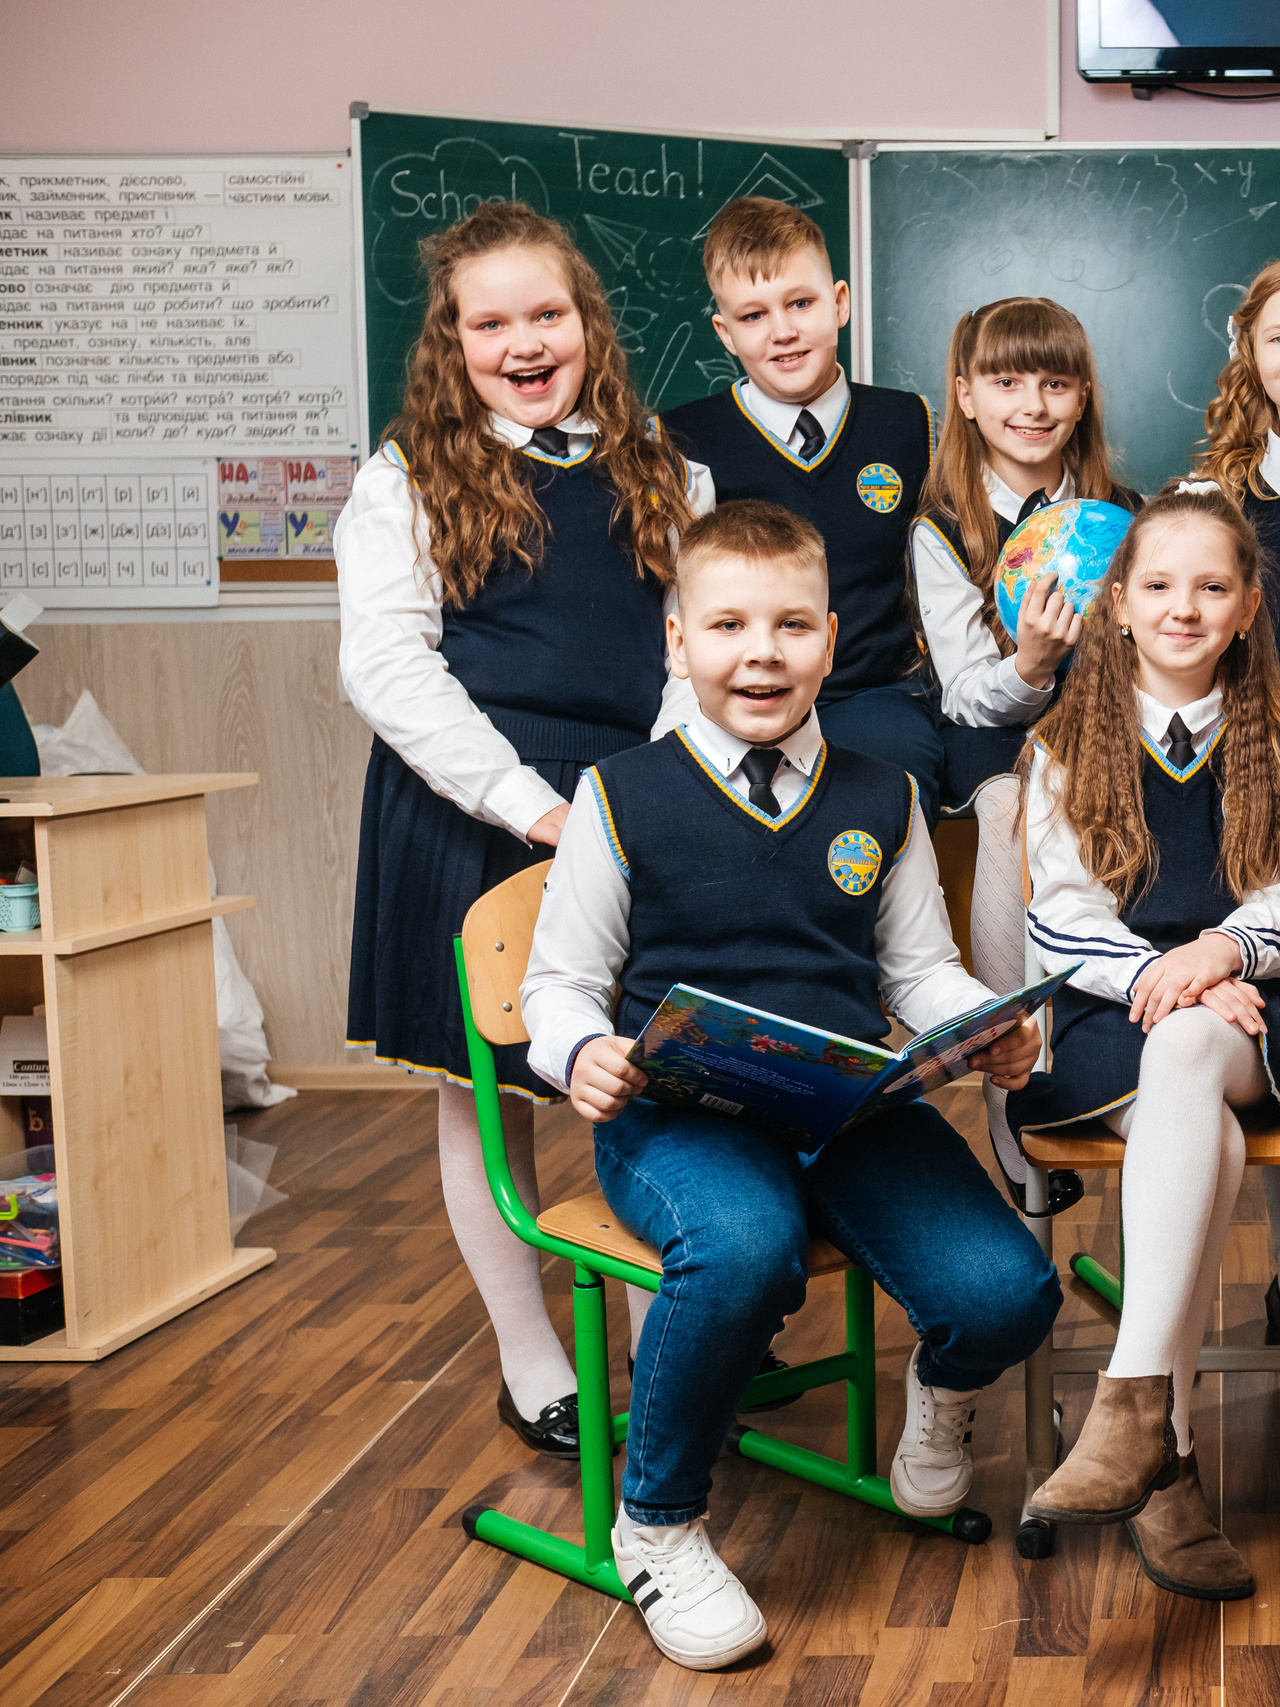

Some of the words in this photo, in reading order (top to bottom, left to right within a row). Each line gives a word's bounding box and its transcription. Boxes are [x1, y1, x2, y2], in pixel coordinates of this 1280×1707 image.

[20, 176, 110, 188] прикметник,
[228, 172, 305, 185] самостійні
[29, 189, 110, 203] займенник,
[119, 189, 197, 204] прислівник
[228, 192, 286, 204] частини
[293, 192, 334, 203] мови.
[391, 169, 517, 220] Schol
[26, 209, 86, 221] називає
[94, 209, 156, 223] предмет
[37, 229, 54, 240] на
[63, 229, 122, 240] питання
[131, 224, 163, 240] хто?
[172, 224, 203, 240] що?
[63, 246, 123, 257] називає
[131, 247, 182, 260] ознаку
[190, 245, 260, 260] предмета
[38, 265, 56, 276] на
[65, 265, 124, 276] питання
[132, 261, 174, 275] який?
[183, 260, 216, 274] яка?
[225, 260, 258, 274] яке?
[266, 259, 294, 273] які?
[35, 283, 93, 294] означає
[110, 280, 135, 294] дію
[143, 281, 213, 296] предмета
[40, 301, 58, 312] на
[66, 301, 125, 312] питання
[133, 301, 156, 313] що
[164, 297, 223, 315] робити?
[231, 300, 254, 312] що
[261, 295, 330, 314] зробити?
[111, 319, 128, 330] на
[140, 319, 158, 330] не
[166, 317, 225, 329] називає
[13, 337, 79, 351] предмет,
[88, 337, 141, 351] ознаку,
[150, 334, 216, 348] кількість,
[225, 336, 251, 347] але
[46, 355, 112, 366] позначає
[119, 352, 180, 366] кількість
[188, 351, 260, 367] предметів
[268, 351, 294, 365] або
[1, 374, 60, 387] порядок
[67, 371, 89, 386] під
[95, 374, 120, 384] час
[127, 370, 164, 384] лічби
[172, 372, 187, 383] та
[194, 369, 269, 384] відповідає
[53, 391, 113, 407] скільки?
[115, 412, 129, 423] та
[137, 408, 209, 424] відповідає
[217, 411, 234, 421] на
[241, 409, 298, 421] питання
[305, 407, 329, 421] як?
[35, 431, 84, 445] ознаку
[115, 425, 155, 439] коли?
[162, 424, 188, 439] де?
[196, 424, 237, 441] куди?
[245, 423, 296, 439] звідки?
[304, 425, 319, 436] та
[220, 462, 249, 484] НА
[288, 462, 317, 484] НА
